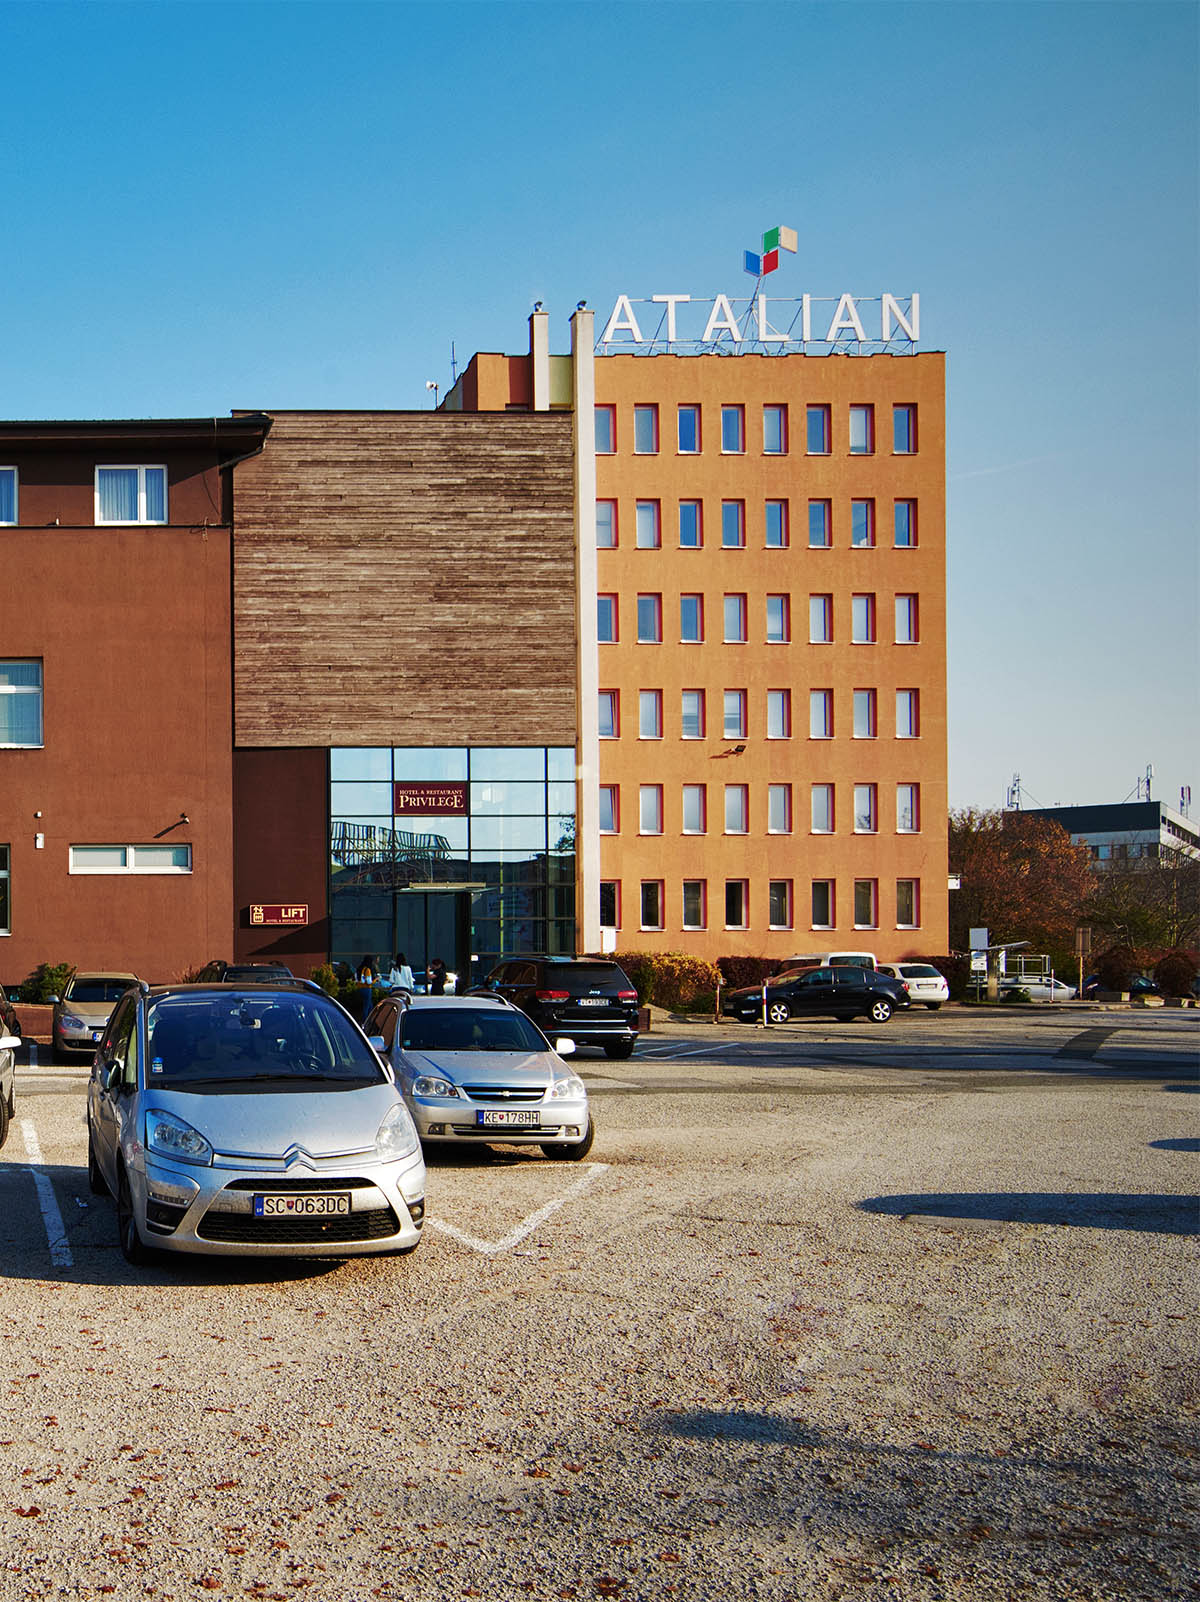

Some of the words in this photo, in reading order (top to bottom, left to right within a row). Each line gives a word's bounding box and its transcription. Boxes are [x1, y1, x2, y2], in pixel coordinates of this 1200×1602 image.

[602, 293, 920, 343] ATALIAN
[399, 795, 464, 808] PRIVILEGE
[281, 908, 305, 918] LIFT
